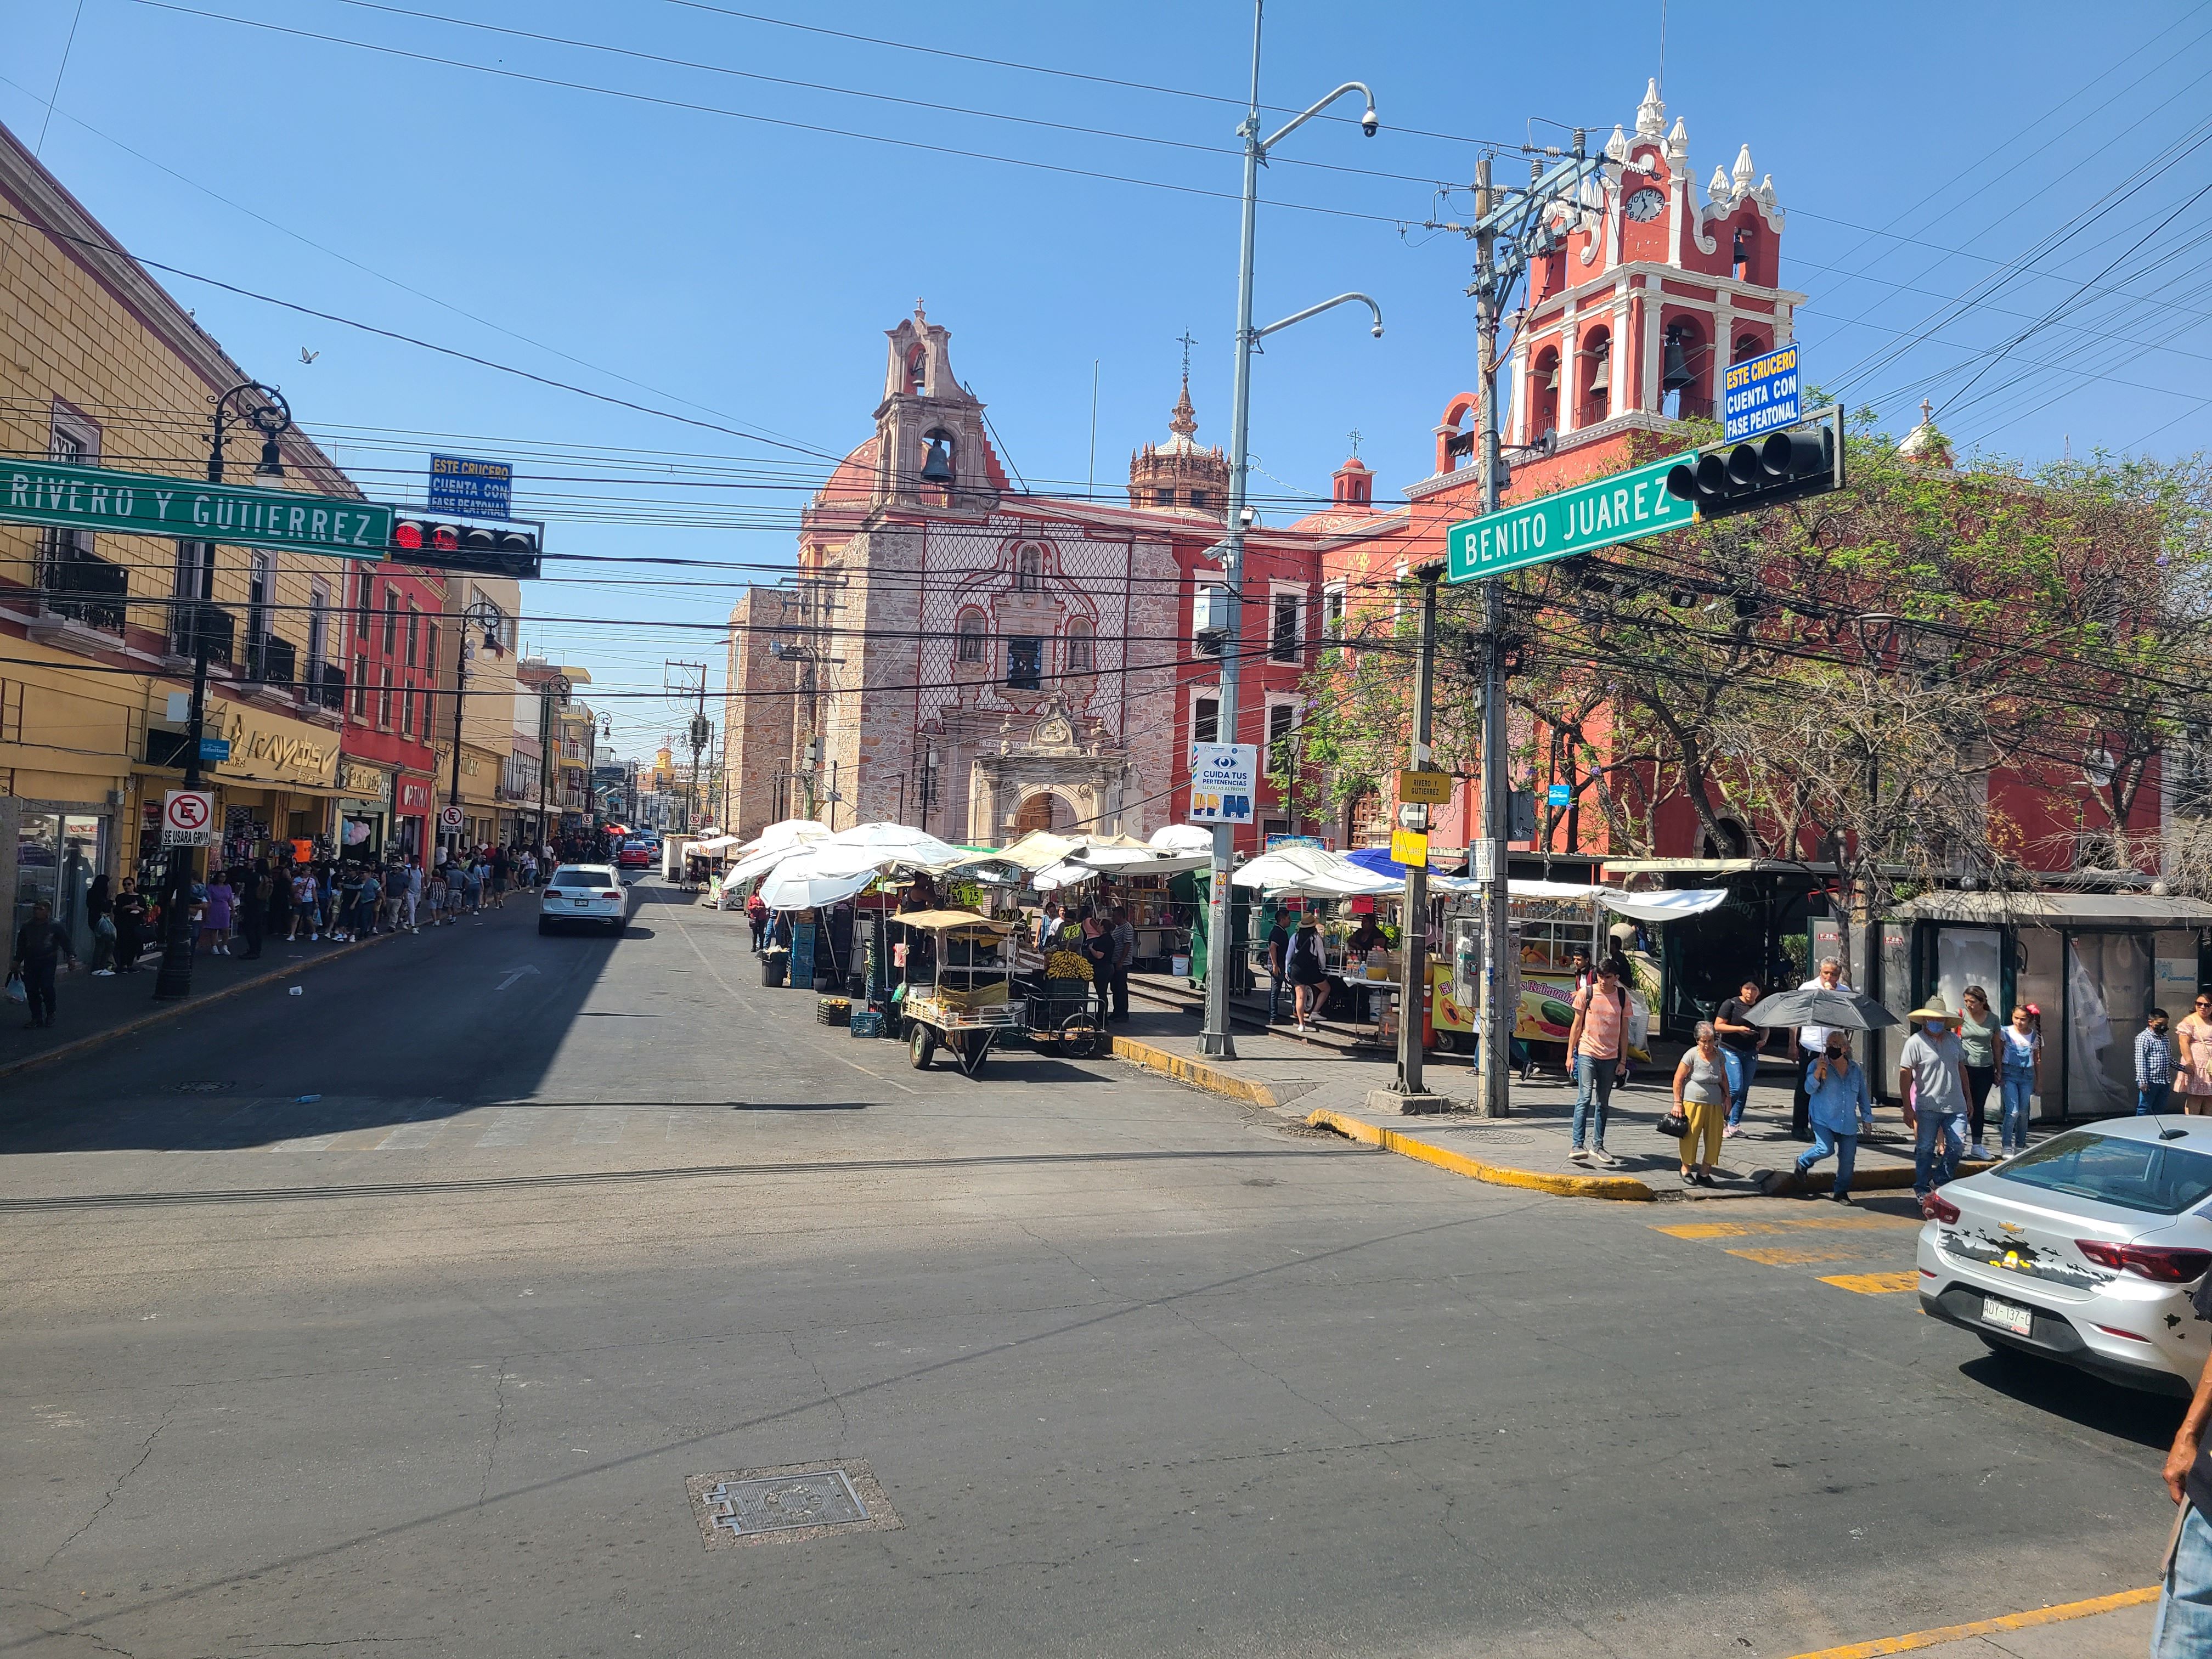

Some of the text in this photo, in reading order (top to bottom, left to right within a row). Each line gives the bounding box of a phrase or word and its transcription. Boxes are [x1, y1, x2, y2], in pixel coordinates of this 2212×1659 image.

[1726, 349, 1796, 390] ESTE CRUCERO
[1727, 374, 1797, 414] CUENTA CON
[1727, 400, 1797, 438] FASE PEATONAL
[434, 459, 509, 481] ESTE CRUCERO
[433, 477, 507, 500] CUENTA CON
[10, 473, 371, 547] RIVERO Y GUTIERREZ
[431, 497, 506, 517] FASE PEATONAL
[1465, 476, 1670, 567] BENITO JUAREZ
[1203, 770, 1230, 778] CUIDA
[1411, 787, 1439, 795] GUTIERREZ
[164, 830, 172, 843] SE
[173, 830, 191, 844] USARA
[969, 891, 979, 901] 25
[1439, 981, 1452, 995] El
